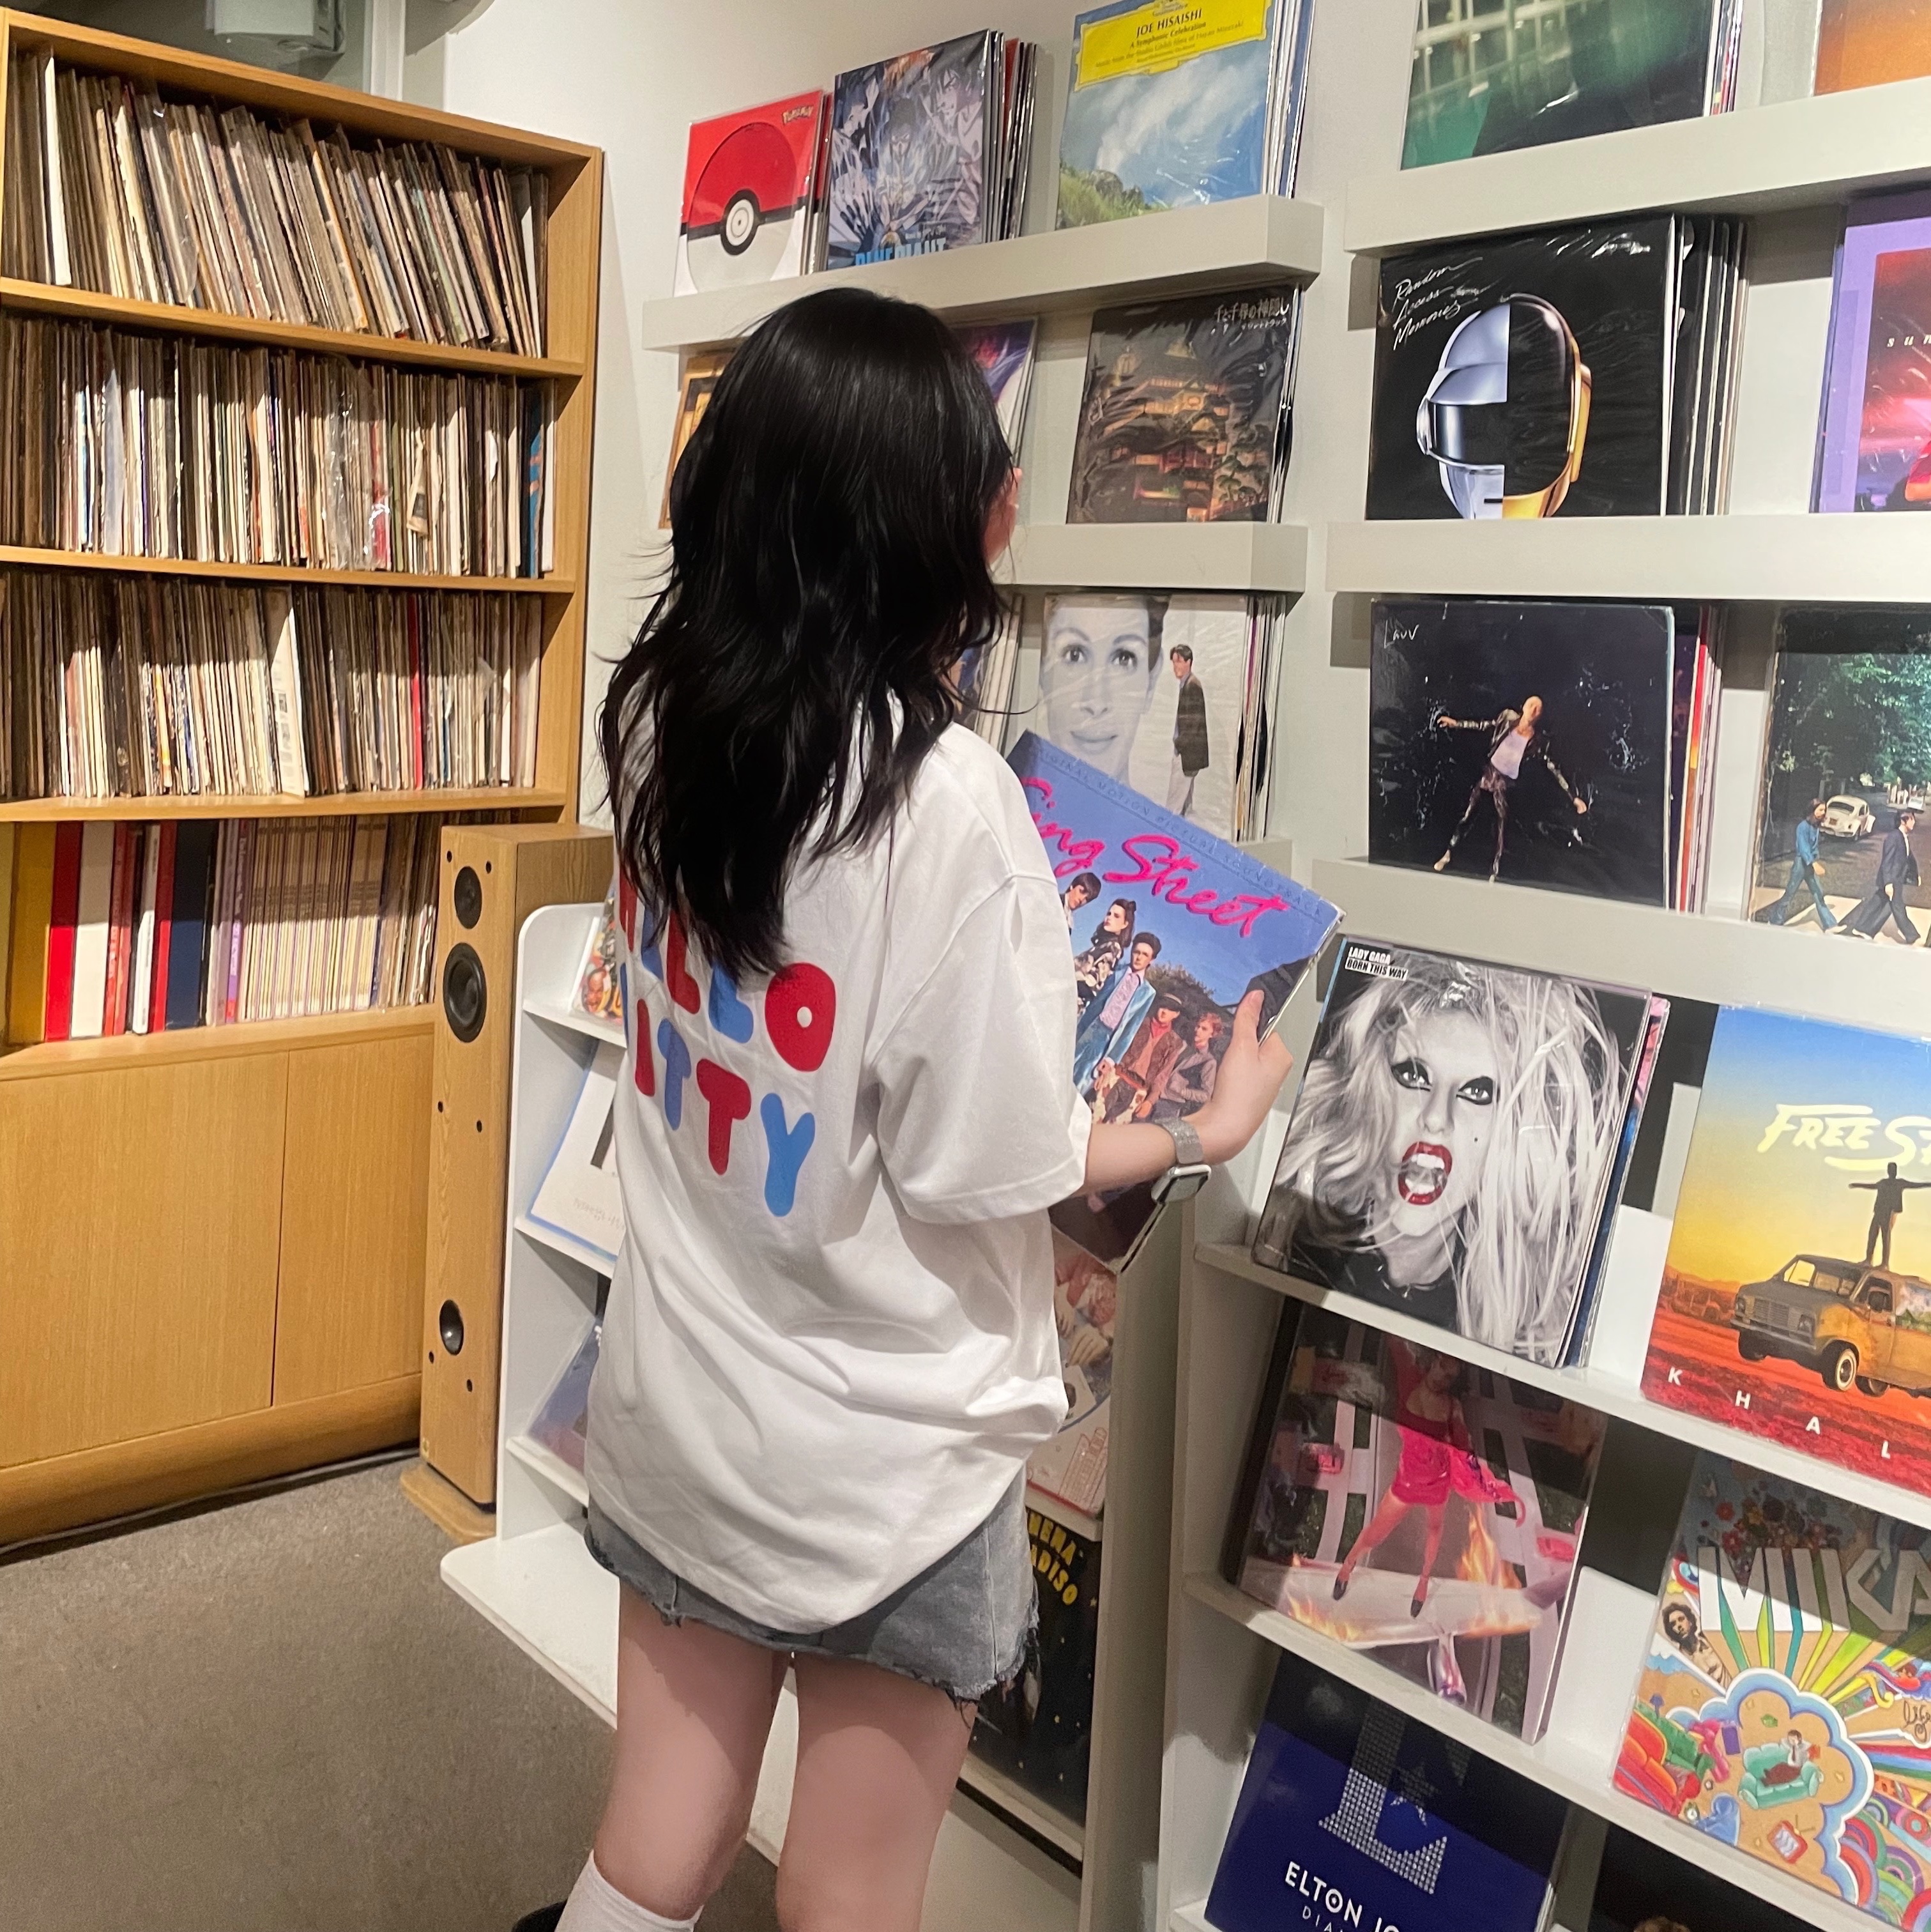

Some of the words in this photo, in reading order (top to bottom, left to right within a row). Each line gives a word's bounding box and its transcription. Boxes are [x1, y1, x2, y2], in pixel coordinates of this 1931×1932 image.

[1136, 24, 1152, 38] JOE
[1157, 8, 1202, 31] HISAISHI
[1391, 256, 1483, 313] Random
[1393, 286, 1454, 330] Access
[1393, 298, 1479, 351] Memories
[1383, 620, 1420, 648] Lauv
[1101, 832, 1290, 938] Street
[1347, 959, 1368, 972] BORN
[1370, 963, 1387, 976] THIS
[1389, 967, 1407, 979] WAY
[1348, 946, 1370, 960] LADY
[1368, 951, 1391, 965] GAGA
[620, 962, 816, 1218] ITTY
[1757, 1104, 1881, 1153] FREE
[1696, 1545, 1931, 1632] MIKA
[1285, 1860, 1363, 1929] ELTON
[1302, 1905, 1344, 1932] DIA
